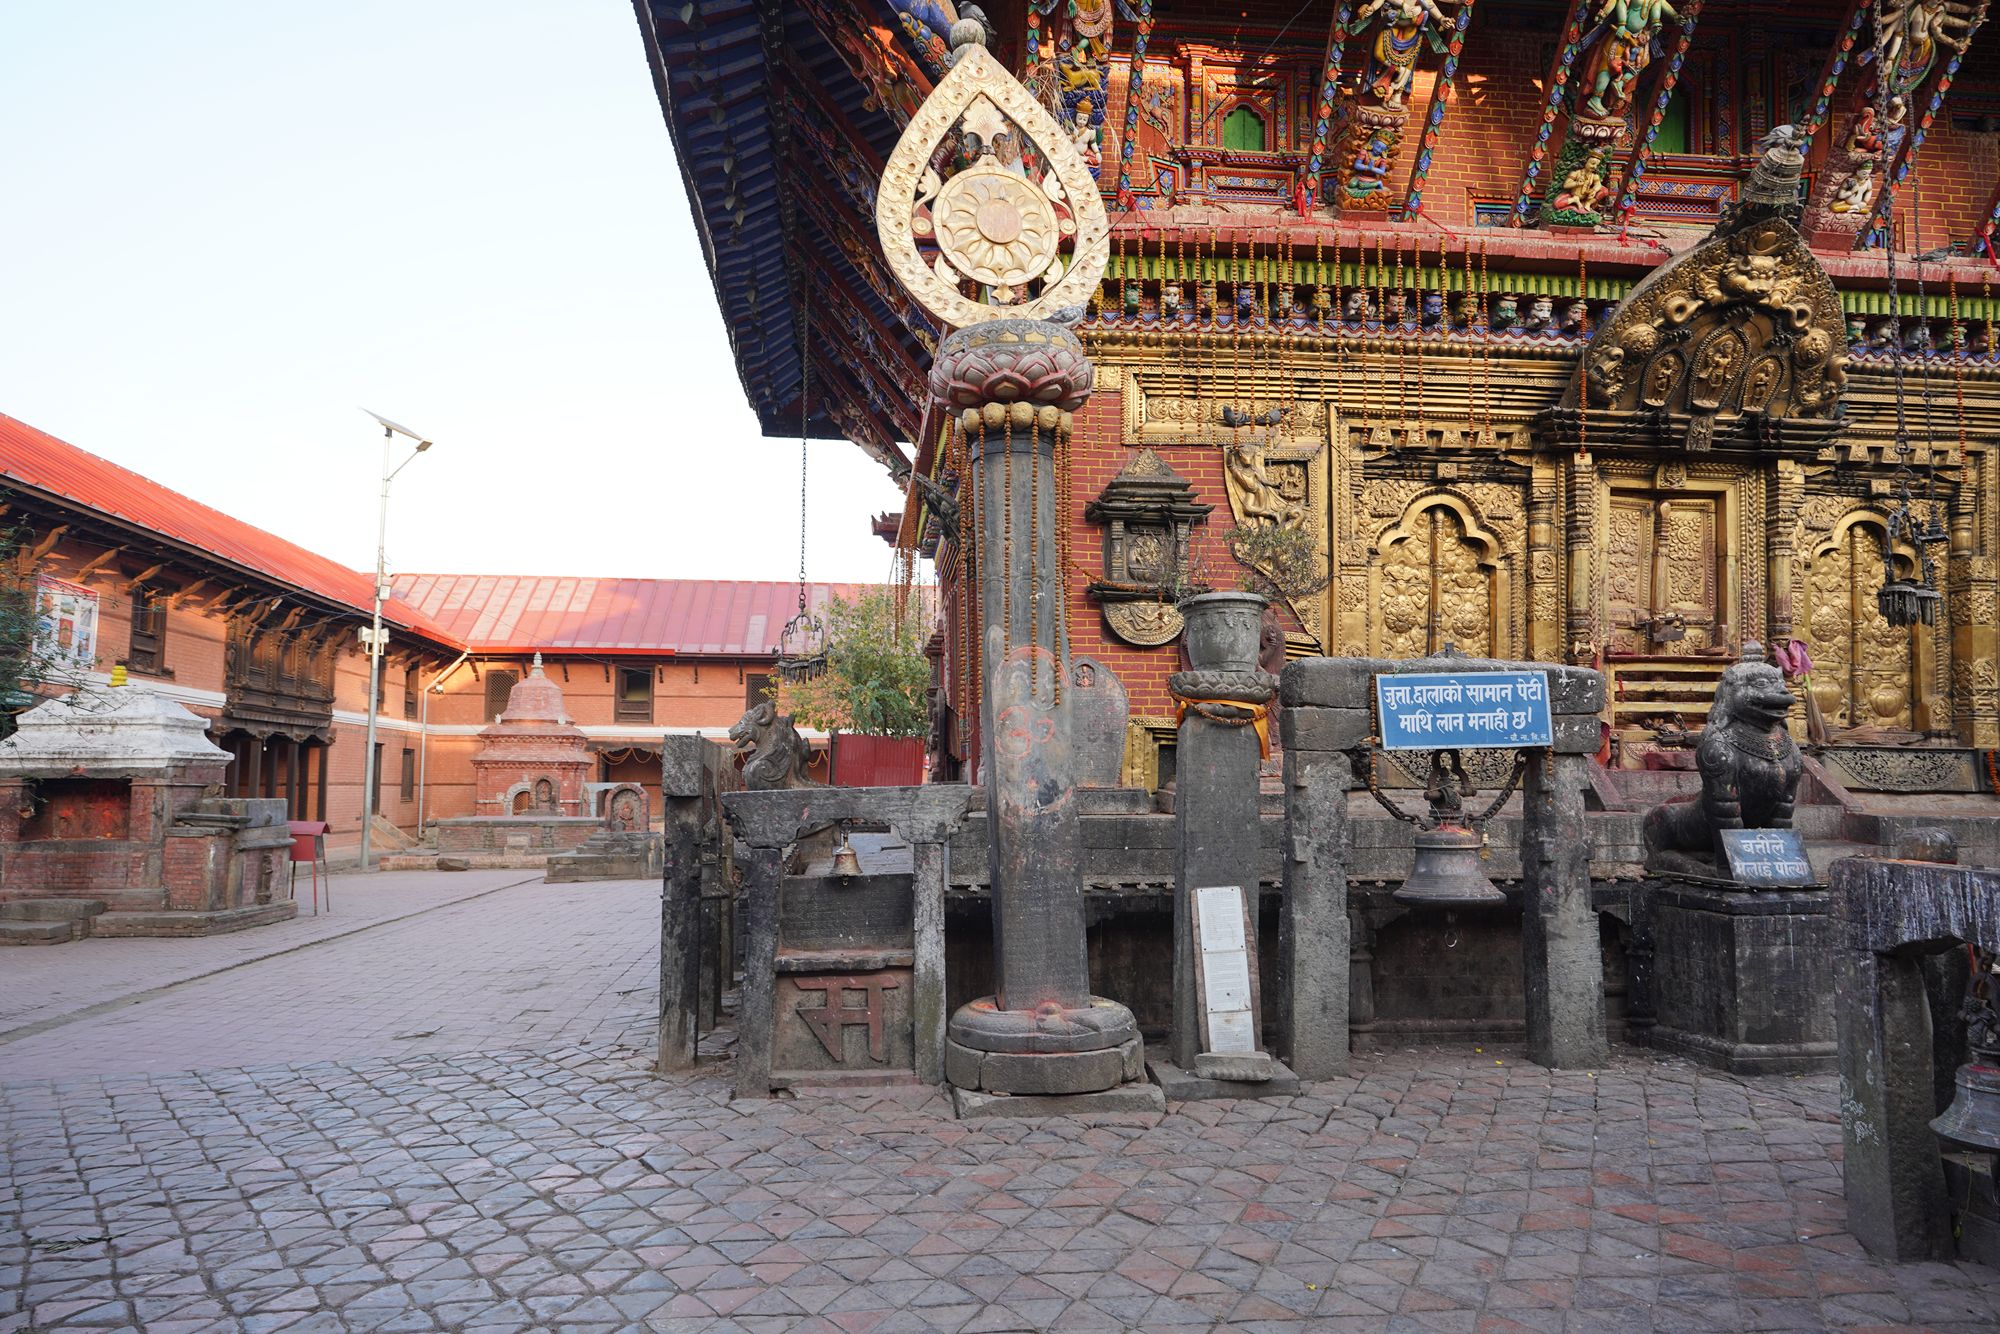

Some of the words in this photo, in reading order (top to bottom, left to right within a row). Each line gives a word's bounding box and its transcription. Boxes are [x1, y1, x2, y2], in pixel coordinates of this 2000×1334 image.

[1465, 684, 1513, 705] सामान
[1516, 678, 1542, 701] पेटी
[1398, 708, 1433, 734] माथि
[1436, 713, 1464, 734] लान
[1467, 707, 1508, 732] मनाही
